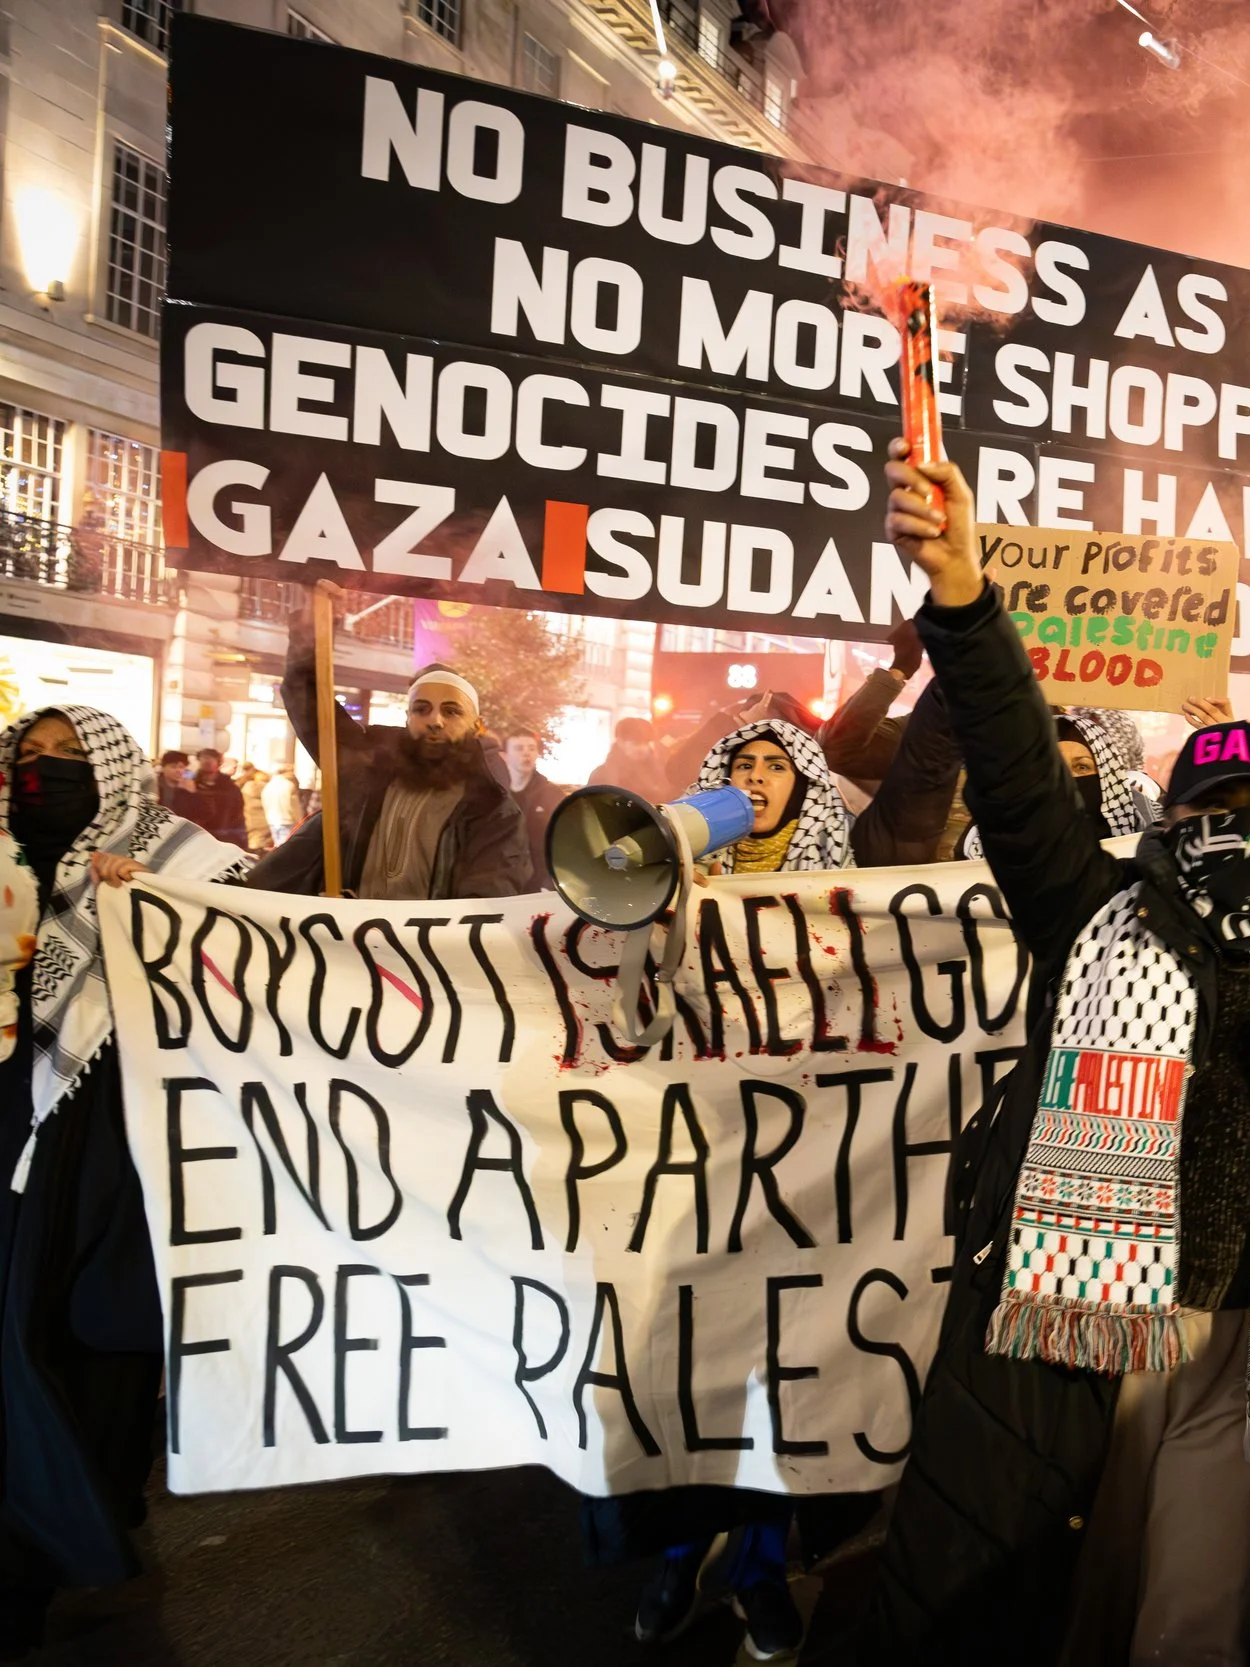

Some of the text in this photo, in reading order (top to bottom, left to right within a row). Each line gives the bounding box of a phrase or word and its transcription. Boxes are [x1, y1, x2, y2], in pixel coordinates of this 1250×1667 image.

[361, 75, 525, 204] NO
[561, 123, 1090, 327] BUSINESS
[1114, 263, 1228, 355] AS
[491, 237, 644, 356] NO
[184, 322, 874, 512] GENOCIDES
[945, 441, 1095, 531] RE
[186, 459, 543, 592] GAZA
[584, 507, 929, 626] SUDAN
[1064, 585, 1231, 627] covered
[1027, 647, 1163, 688] BLOOD
[128, 888, 516, 1068] BOYCOTT
[163, 1077, 402, 1244] END
[170, 1264, 448, 1454] FREE
